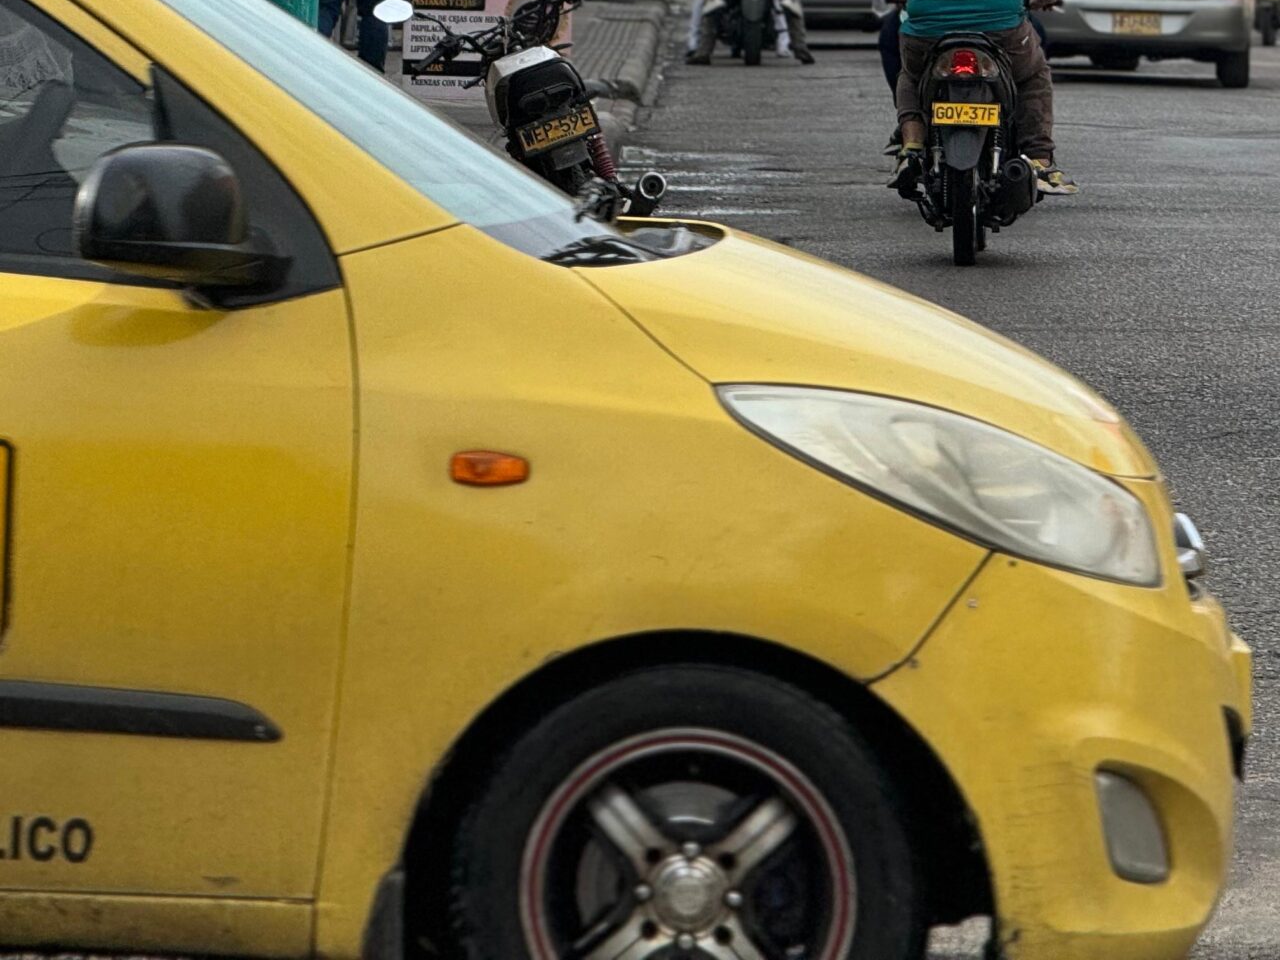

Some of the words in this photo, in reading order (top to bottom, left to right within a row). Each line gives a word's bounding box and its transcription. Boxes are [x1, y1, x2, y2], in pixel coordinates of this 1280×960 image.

[437, 15, 447, 23] DE
[448, 16, 467, 25] CEJAS
[0, 816, 94, 863] ICO
